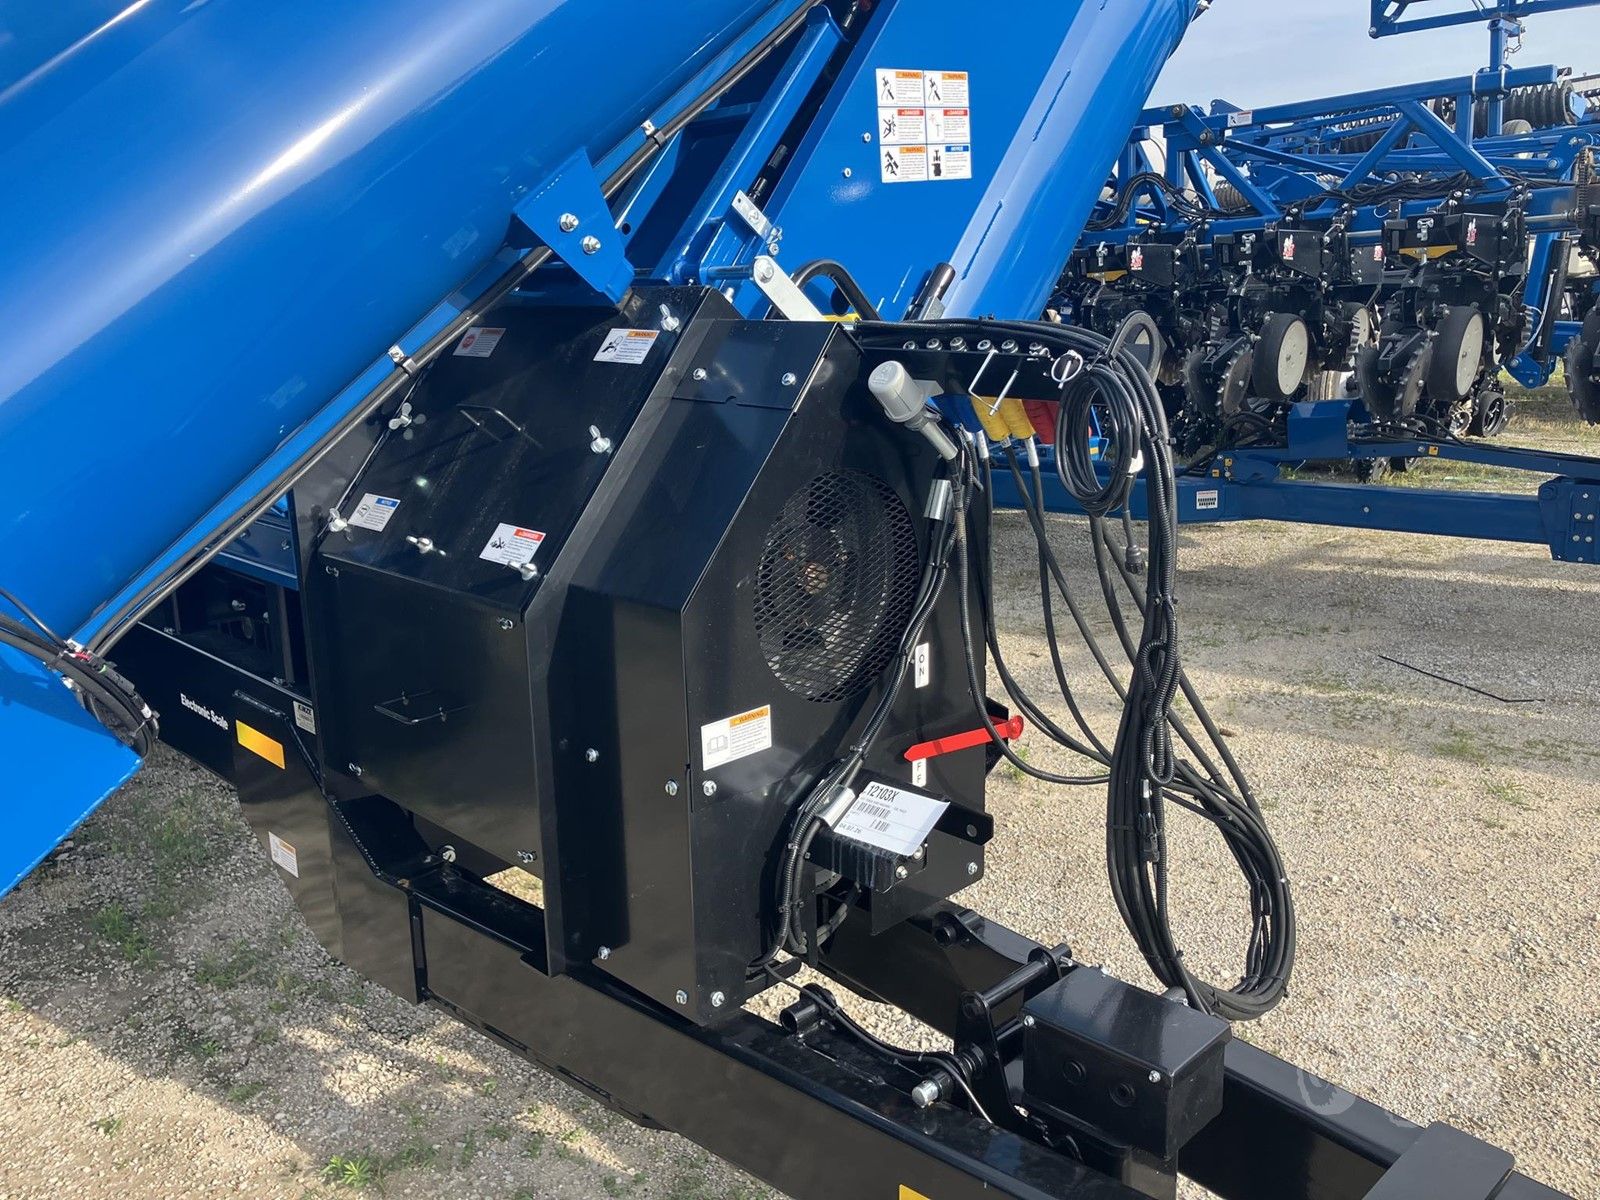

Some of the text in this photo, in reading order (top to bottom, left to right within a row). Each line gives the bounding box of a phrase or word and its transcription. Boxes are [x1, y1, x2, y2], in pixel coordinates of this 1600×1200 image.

[180, 692, 229, 730] Electronic Scale
[866, 784, 900, 803] 12103X
